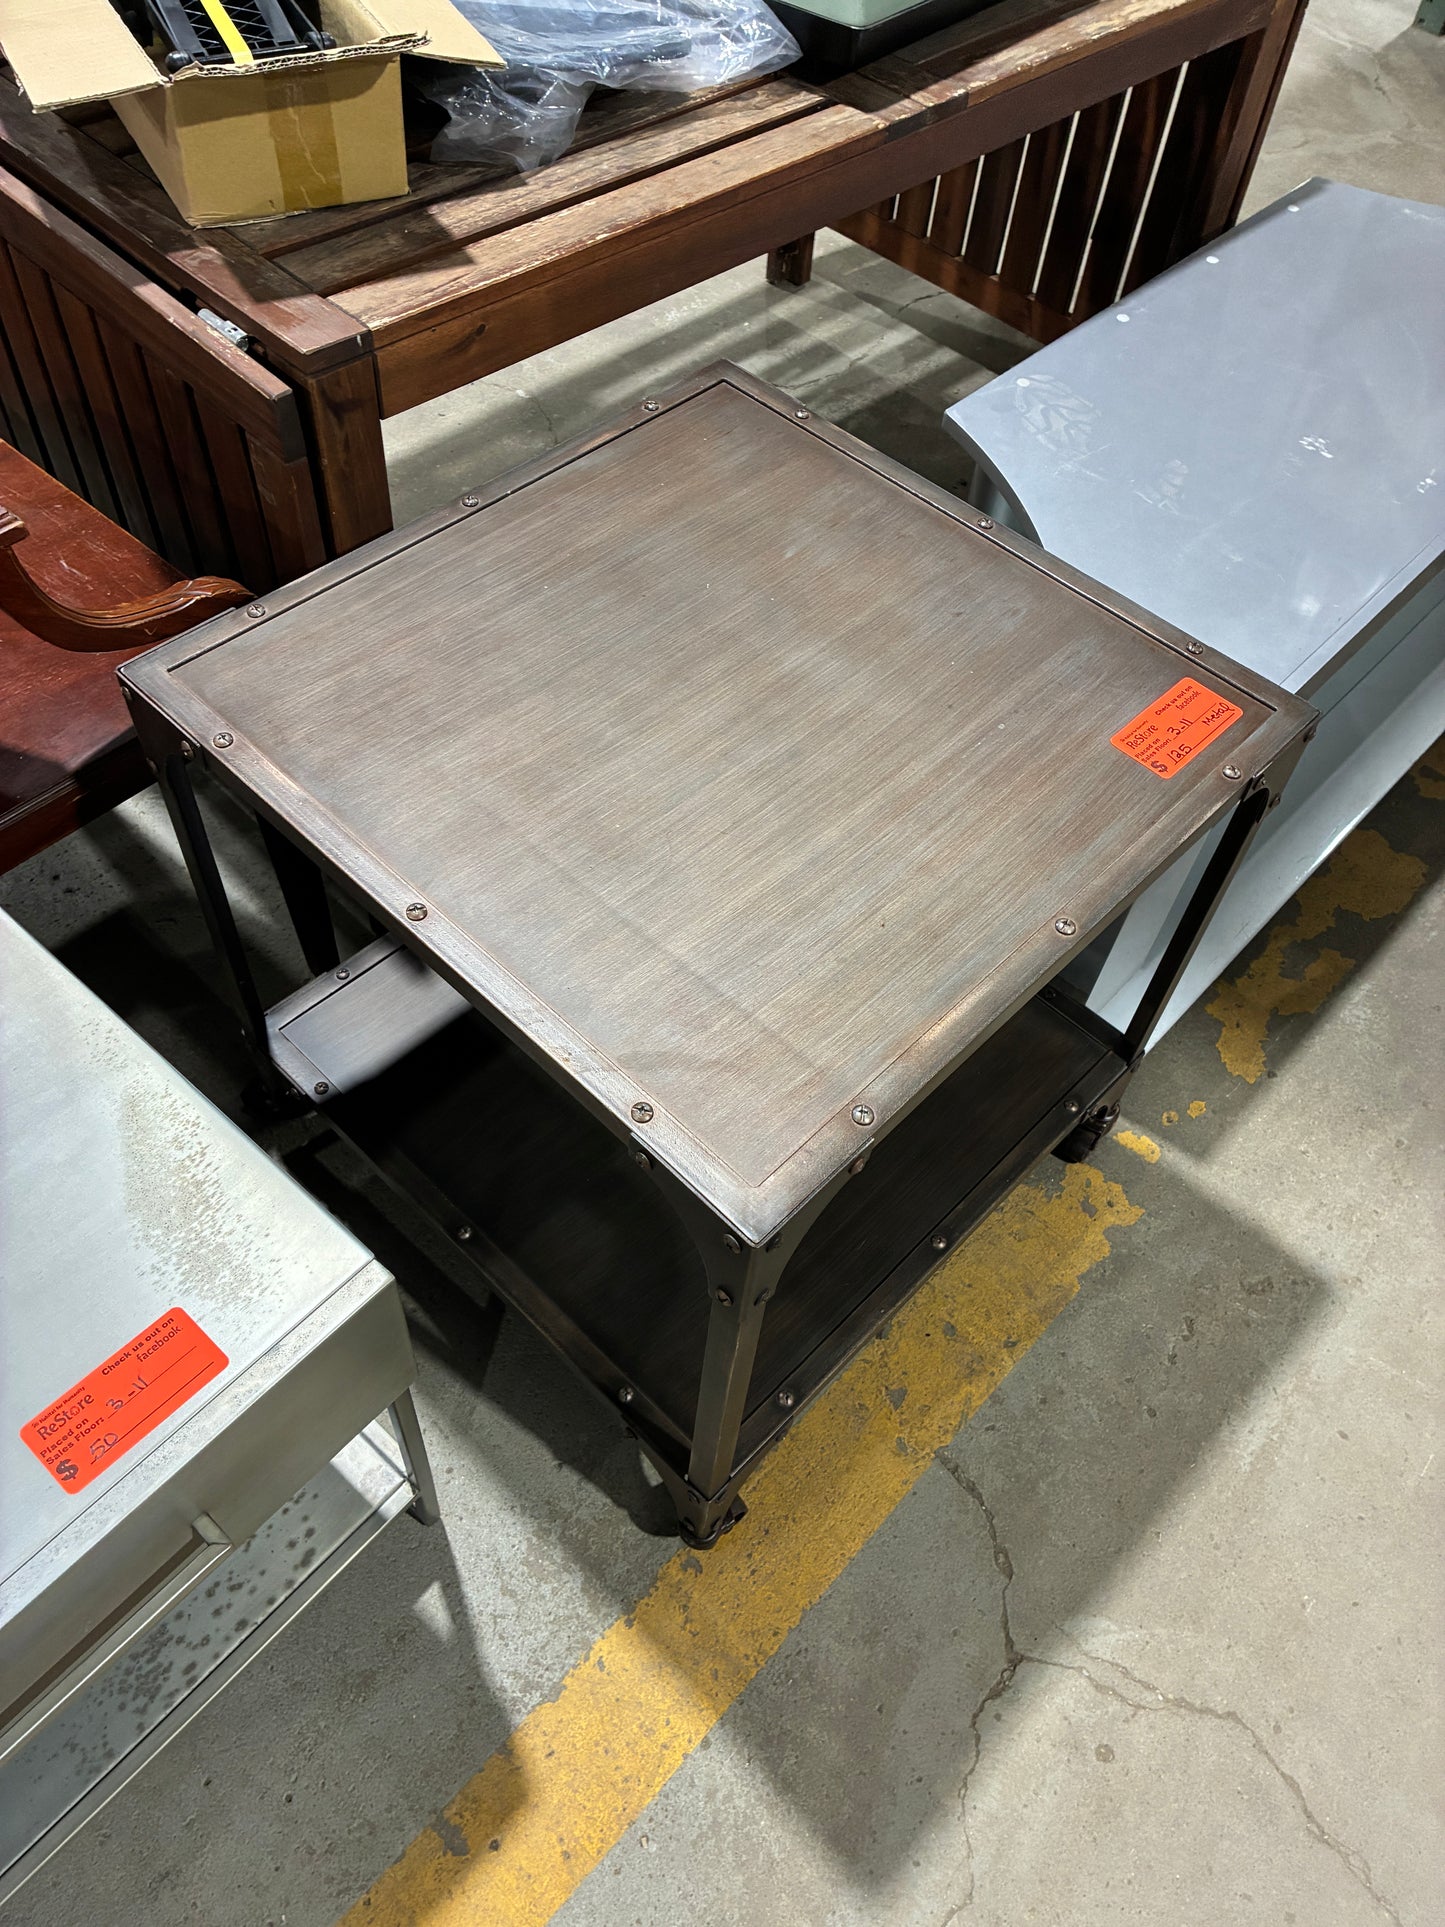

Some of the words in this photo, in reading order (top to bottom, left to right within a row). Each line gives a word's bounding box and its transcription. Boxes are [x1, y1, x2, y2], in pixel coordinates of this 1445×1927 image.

[1126, 724, 1158, 750] ReStore
[1151, 760, 1168, 773] $
[101, 1351, 132, 1376] Check
[132, 1341, 145, 1353] us
[145, 1328, 161, 1342] out
[161, 1317, 174, 1329] on
[36, 1393, 94, 1440] ReStore
[39, 1430, 75, 1459] Placed
[75, 1417, 89, 1430] on
[46, 1439, 75, 1465] Sales
[74, 1417, 105, 1442] Floor:
[56, 1458, 79, 1481] $
